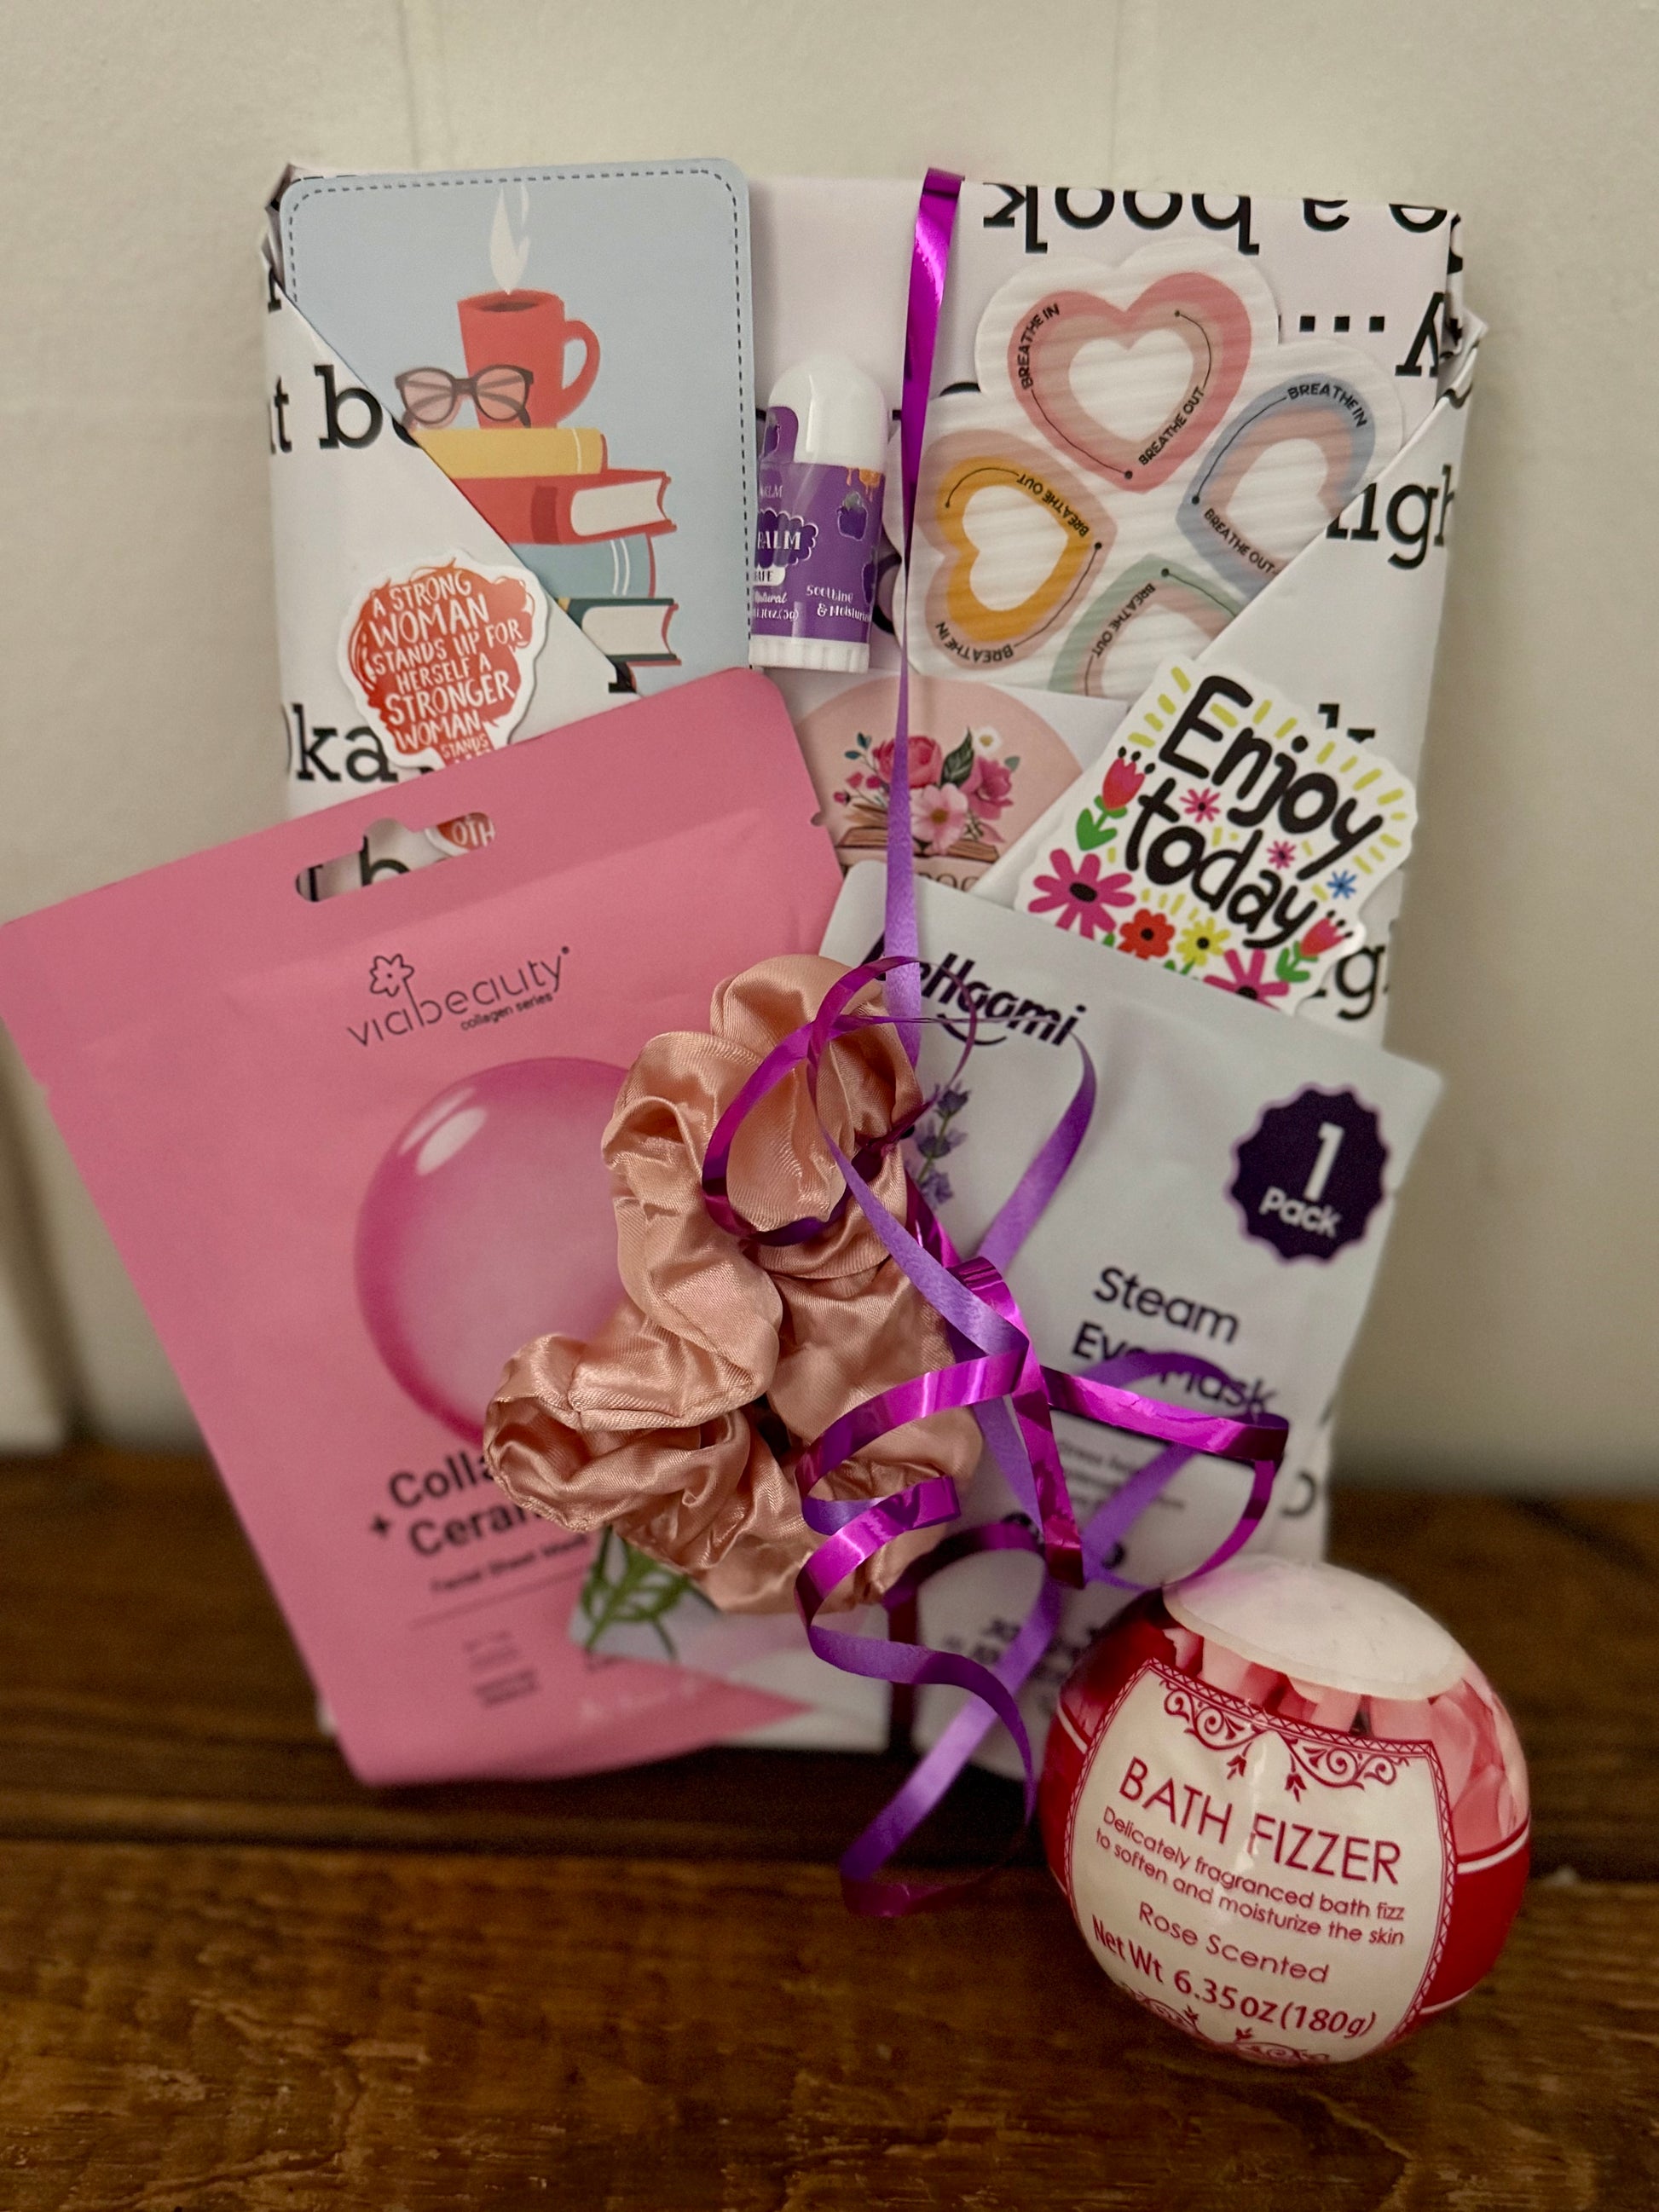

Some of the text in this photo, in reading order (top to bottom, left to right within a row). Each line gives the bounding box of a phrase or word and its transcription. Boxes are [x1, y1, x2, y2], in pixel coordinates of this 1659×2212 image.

[1017, 303, 1060, 390] BREATHE IN
[1139, 385, 1205, 466] BREATHE OUT
[1287, 383, 1367, 428] BREATHE IN
[1016, 473, 1090, 538] BREATHE OUT
[1205, 508, 1275, 575] BREATHE OUT
[369, 593, 489, 648] WOMAN
[373, 572, 471, 618] A STRONG
[817, 603, 828, 617] &
[1092, 582, 1156, 658] BREATHE OUT
[372, 619, 523, 675] STANDS UP FOR
[396, 653, 492, 694] HERSELF A
[936, 621, 1014, 663] BREATHE IN
[385, 670, 515, 725] STRONGER
[394, 709, 482, 750] WOMAN
[441, 734, 488, 758] STANDS
[1159, 675, 1384, 882] Enjoy
[1124, 777, 1318, 950] today
[346, 956, 562, 1047] viabeauty
[461, 991, 553, 1031] collagen series
[1304, 1122, 1344, 1201] 1
[1259, 1187, 1342, 1238] Pack
[1094, 1266, 1240, 1345] Steam
[1119, 1756, 1402, 1886] BATH FIZZER
[1096, 1828, 1404, 1945] to soften and moisturize the skin
[1103, 1805, 1405, 1921] Delicately fragranced bath fizz
[1092, 1915, 1127, 1961] Net
[1128, 1937, 1165, 1984] Wt
[1139, 1901, 1330, 1985] Rose Scented
